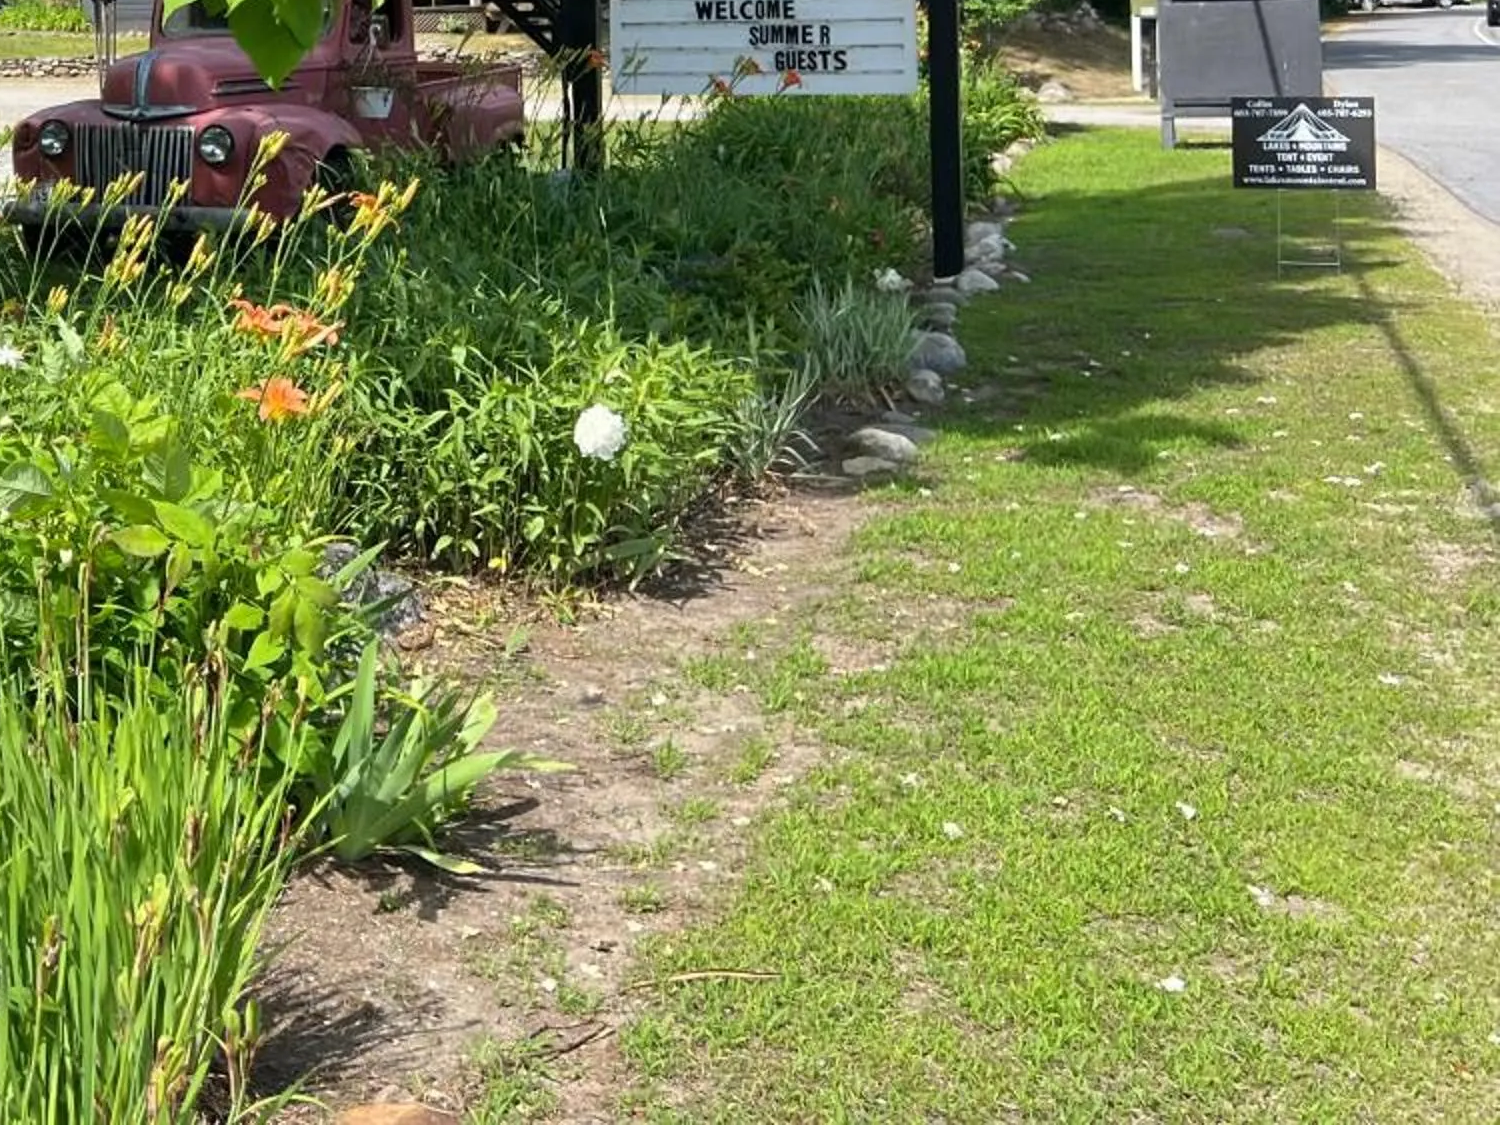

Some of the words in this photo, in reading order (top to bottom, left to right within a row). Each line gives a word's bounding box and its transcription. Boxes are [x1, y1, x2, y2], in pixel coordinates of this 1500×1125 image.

[775, 50, 848, 71] GUESTS
[1263, 142, 1290, 151] LAKES
[1276, 153, 1298, 162] TENT
[1306, 153, 1335, 162] EVENT
[1249, 164, 1276, 173] TENTS
[1286, 164, 1317, 174] TABLES
[1327, 165, 1360, 174] CHAIRS
